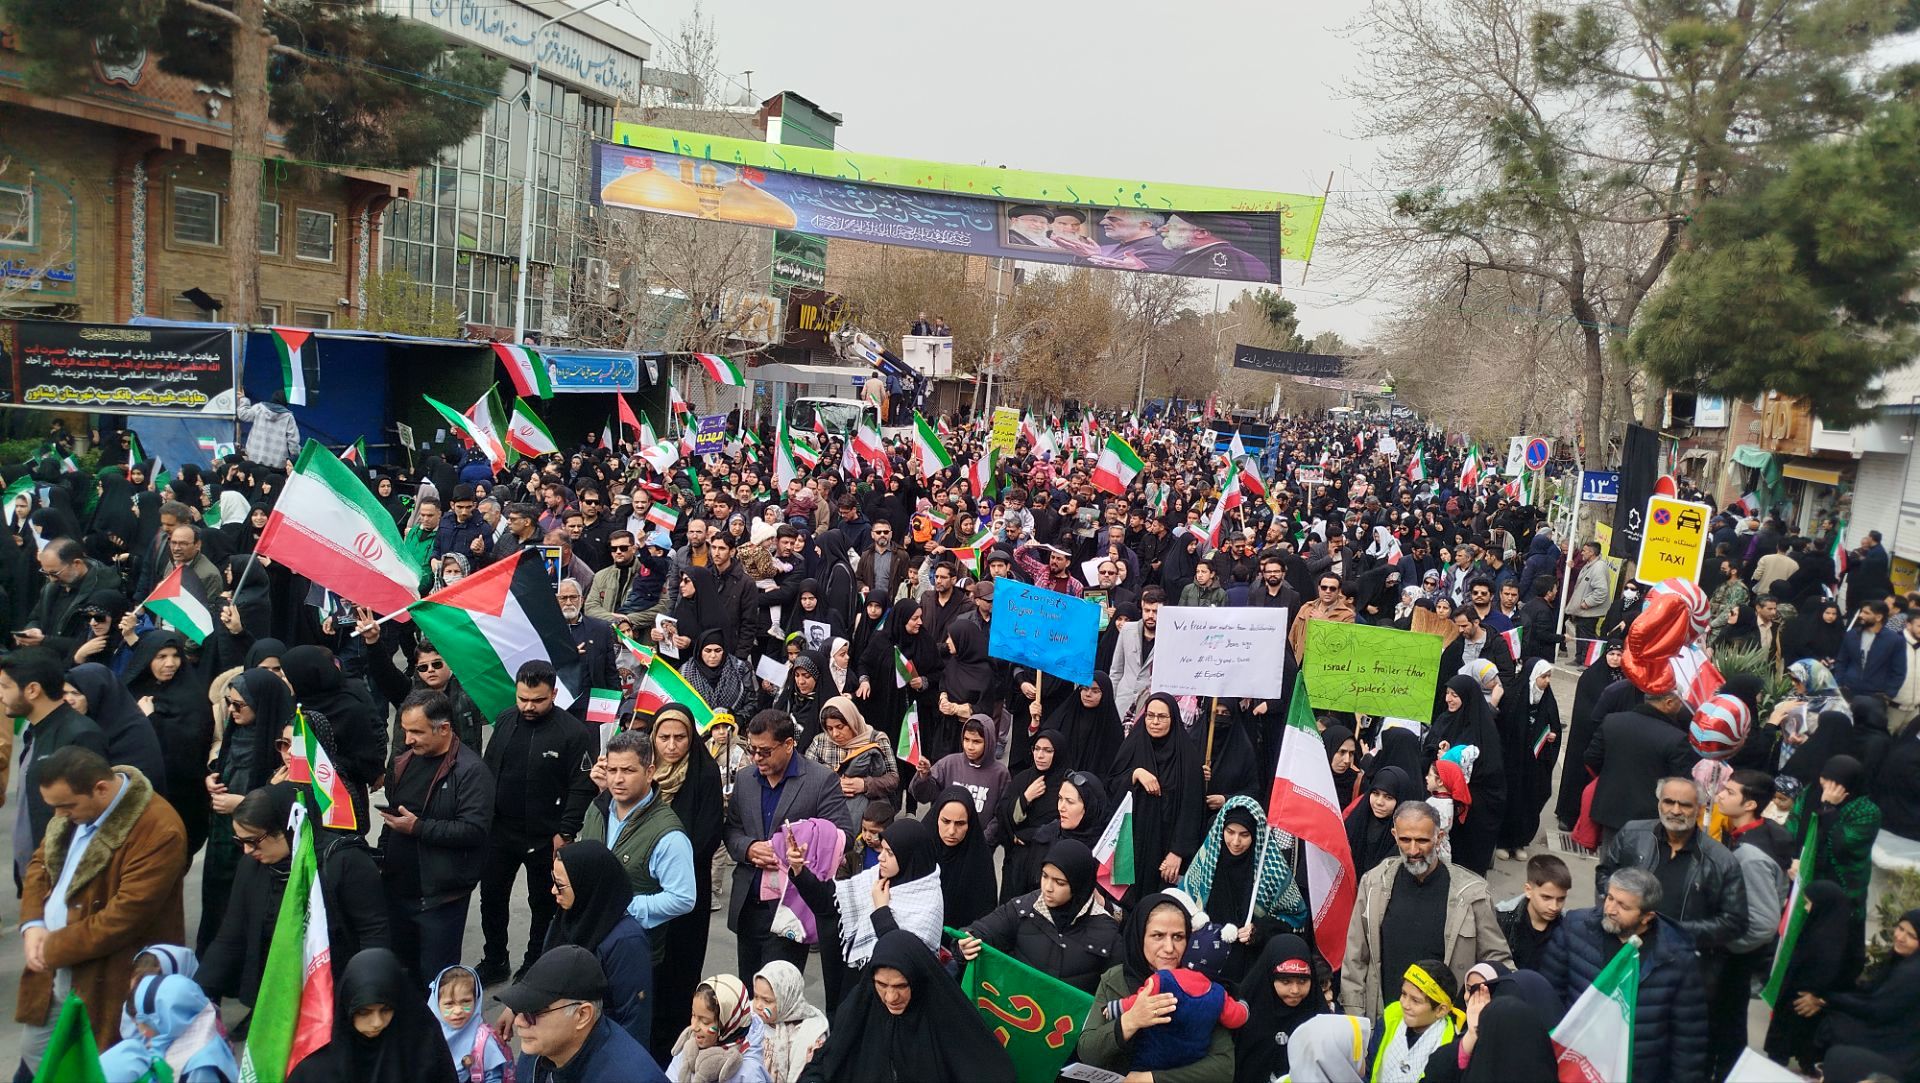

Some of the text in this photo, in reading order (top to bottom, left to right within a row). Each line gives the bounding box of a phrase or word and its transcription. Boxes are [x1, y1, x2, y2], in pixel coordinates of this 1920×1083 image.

[799, 304, 817, 330] VIP
[67, 346, 88, 358] جهان
[89, 348, 120, 359] مسلمین
[120, 349, 132, 360] امر
[153, 350, 177, 361] عالیقدر
[178, 352, 194, 362] رهبر
[195, 352, 220, 362] شهادت
[25, 355, 41, 365] آحاد
[65, 369, 88, 379] تعزیت
[93, 369, 118, 380] تسلیت
[119, 370, 144, 381] اسلامی
[166, 371, 181, 382] ایران
[182, 372, 198, 381] ملت
[27, 385, 57, 401] نیشابور
[1590, 478, 1610, 493] ۱۳
[1649, 536, 1697, 549] ایستگاه تاکسی
[1659, 551, 1685, 566] TAXI
[1174, 620, 1187, 631] We
[1190, 620, 1208, 631] freed
[1323, 660, 1426, 678] israel is frailer than
[1348, 682, 1386, 696] Spider's
